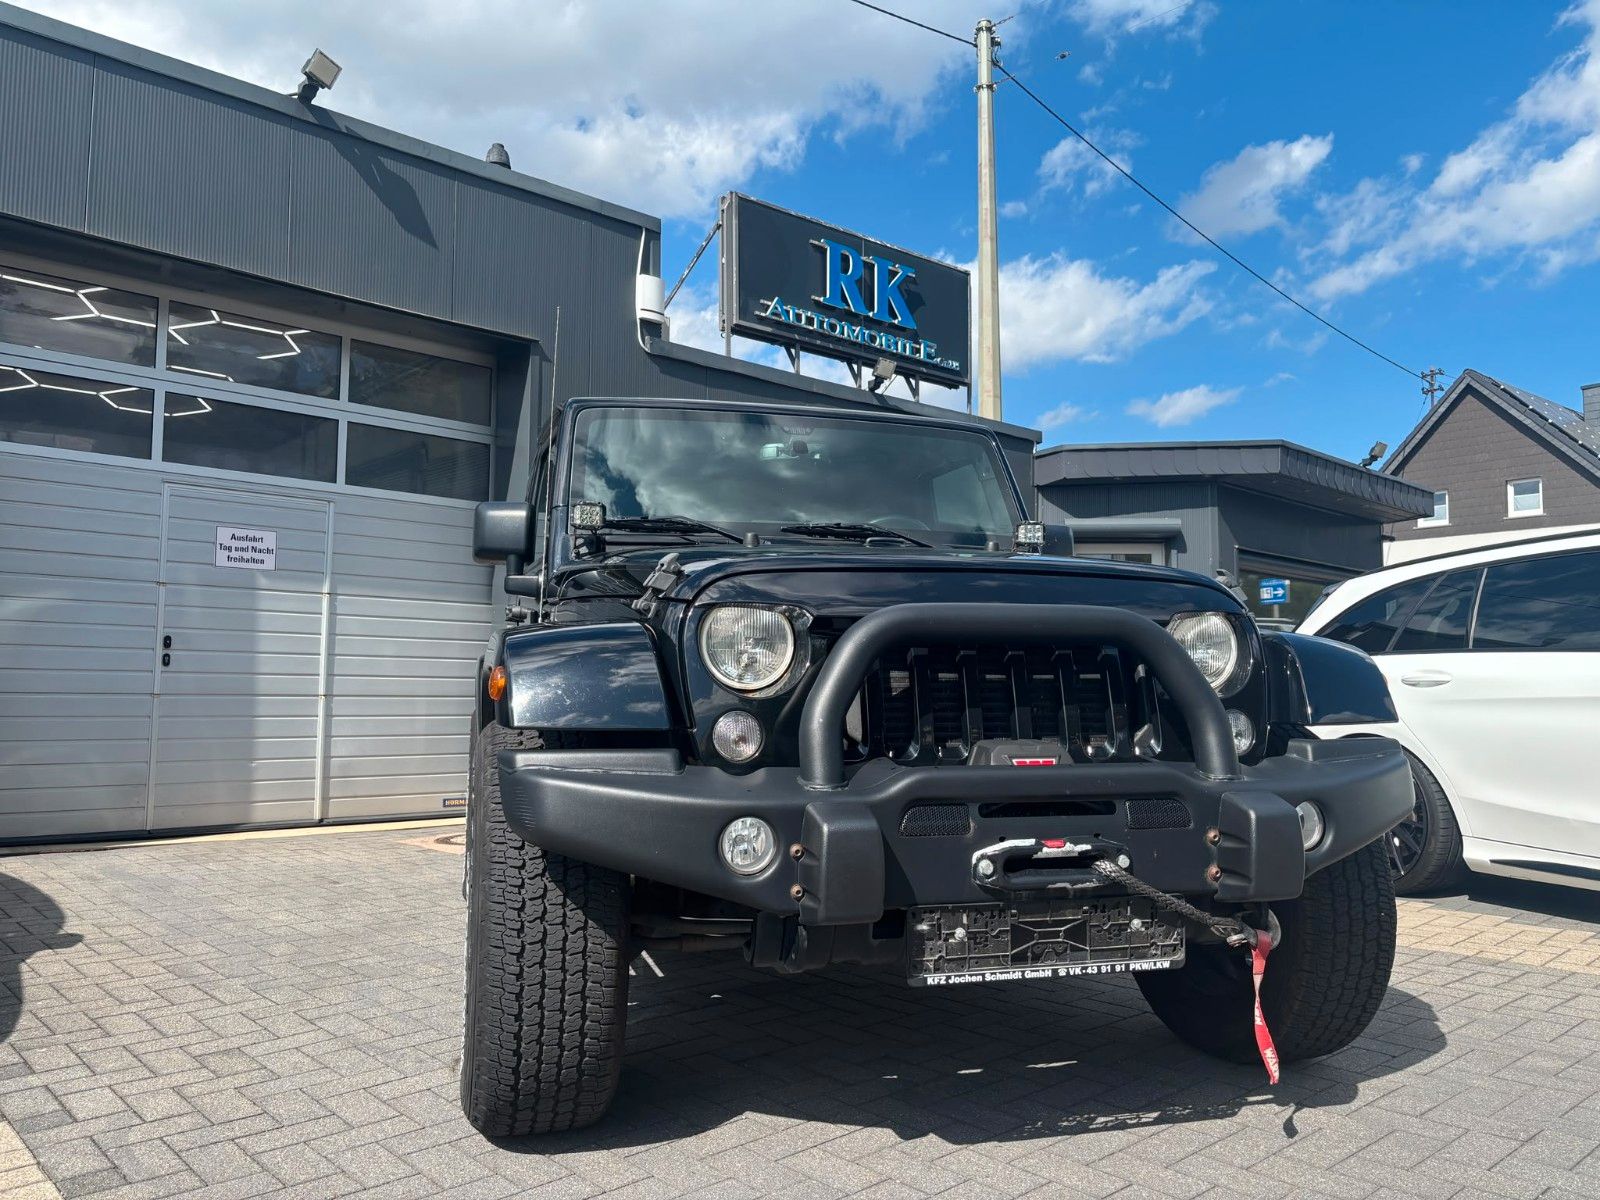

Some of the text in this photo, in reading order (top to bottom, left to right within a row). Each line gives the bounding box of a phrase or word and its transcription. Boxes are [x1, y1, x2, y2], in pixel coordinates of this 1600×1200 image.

[809, 238, 917, 330] RK
[230, 533, 264, 543] Ausfahrt
[219, 542, 274, 555] Tag und Nacht
[227, 554, 265, 565] freihalten
[927, 976, 946, 985] KFZ
[948, 974, 983, 984] Jochen
[984, 971, 1022, 981] Schmidt
[1024, 969, 1052, 978] GmbH
[1100, 964, 1111, 973] 91
[1115, 964, 1125, 972] 91
[1129, 960, 1171, 971] PKW/LKW
